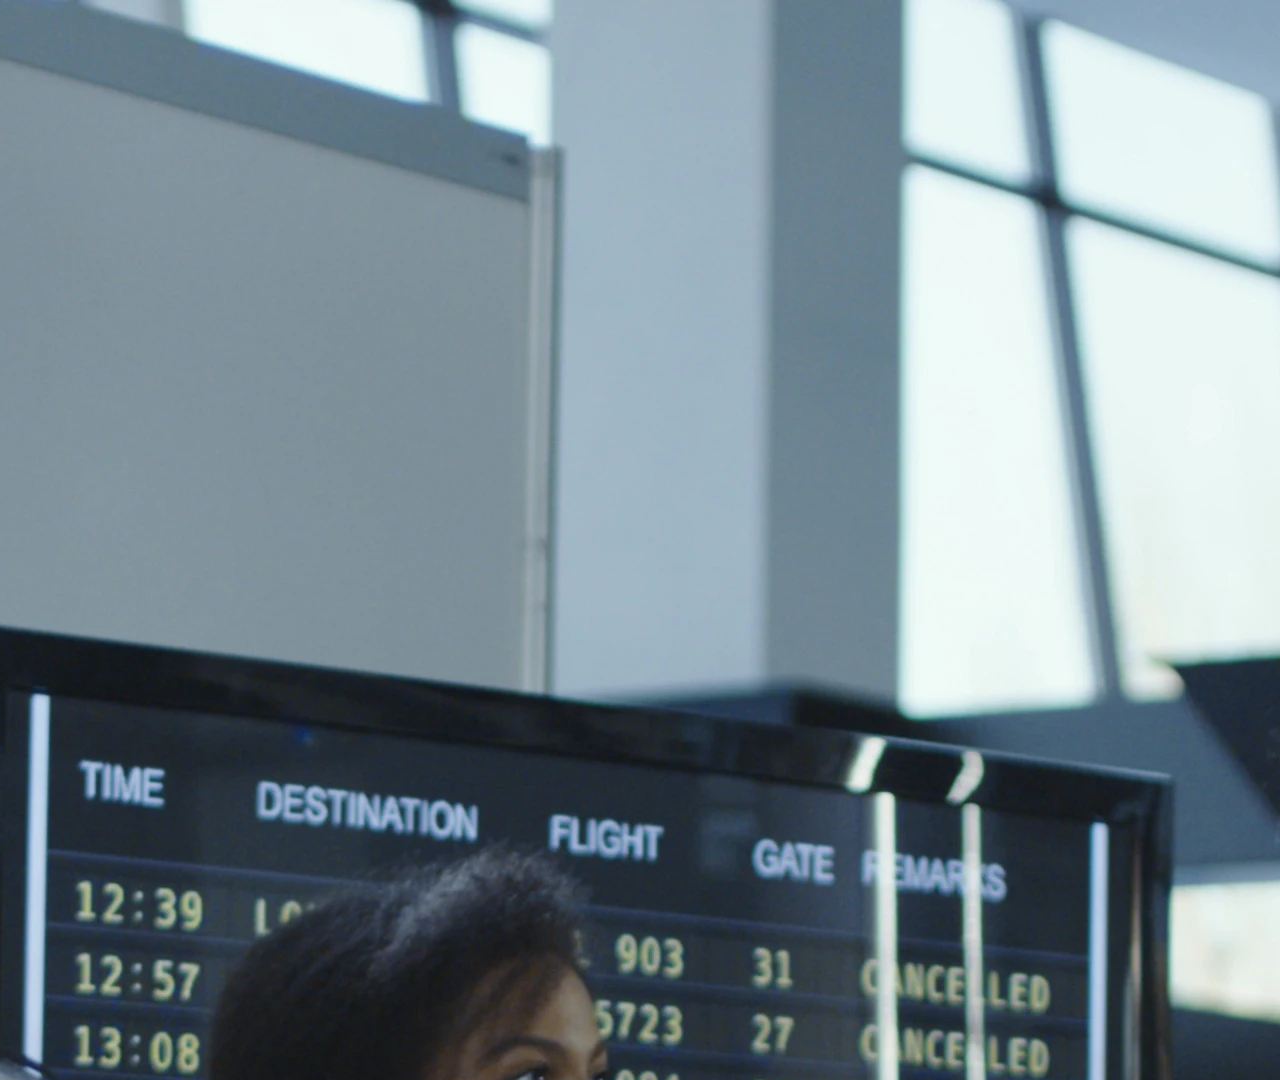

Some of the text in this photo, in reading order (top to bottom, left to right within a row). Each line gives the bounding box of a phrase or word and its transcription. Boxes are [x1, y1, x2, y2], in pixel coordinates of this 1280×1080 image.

[80, 760, 1007, 902] TIME DESTINATION FLIGHT GATE REMARS
[76, 881, 203, 931] 12:39
[616, 933, 685, 979] 903
[753, 948, 792, 989] 31
[860, 958, 1051, 1016] CNCELED
[74, 1026, 200, 1073] 13:08
[75, 953, 1050, 1079] 12:57 5723 27 CNCELED
